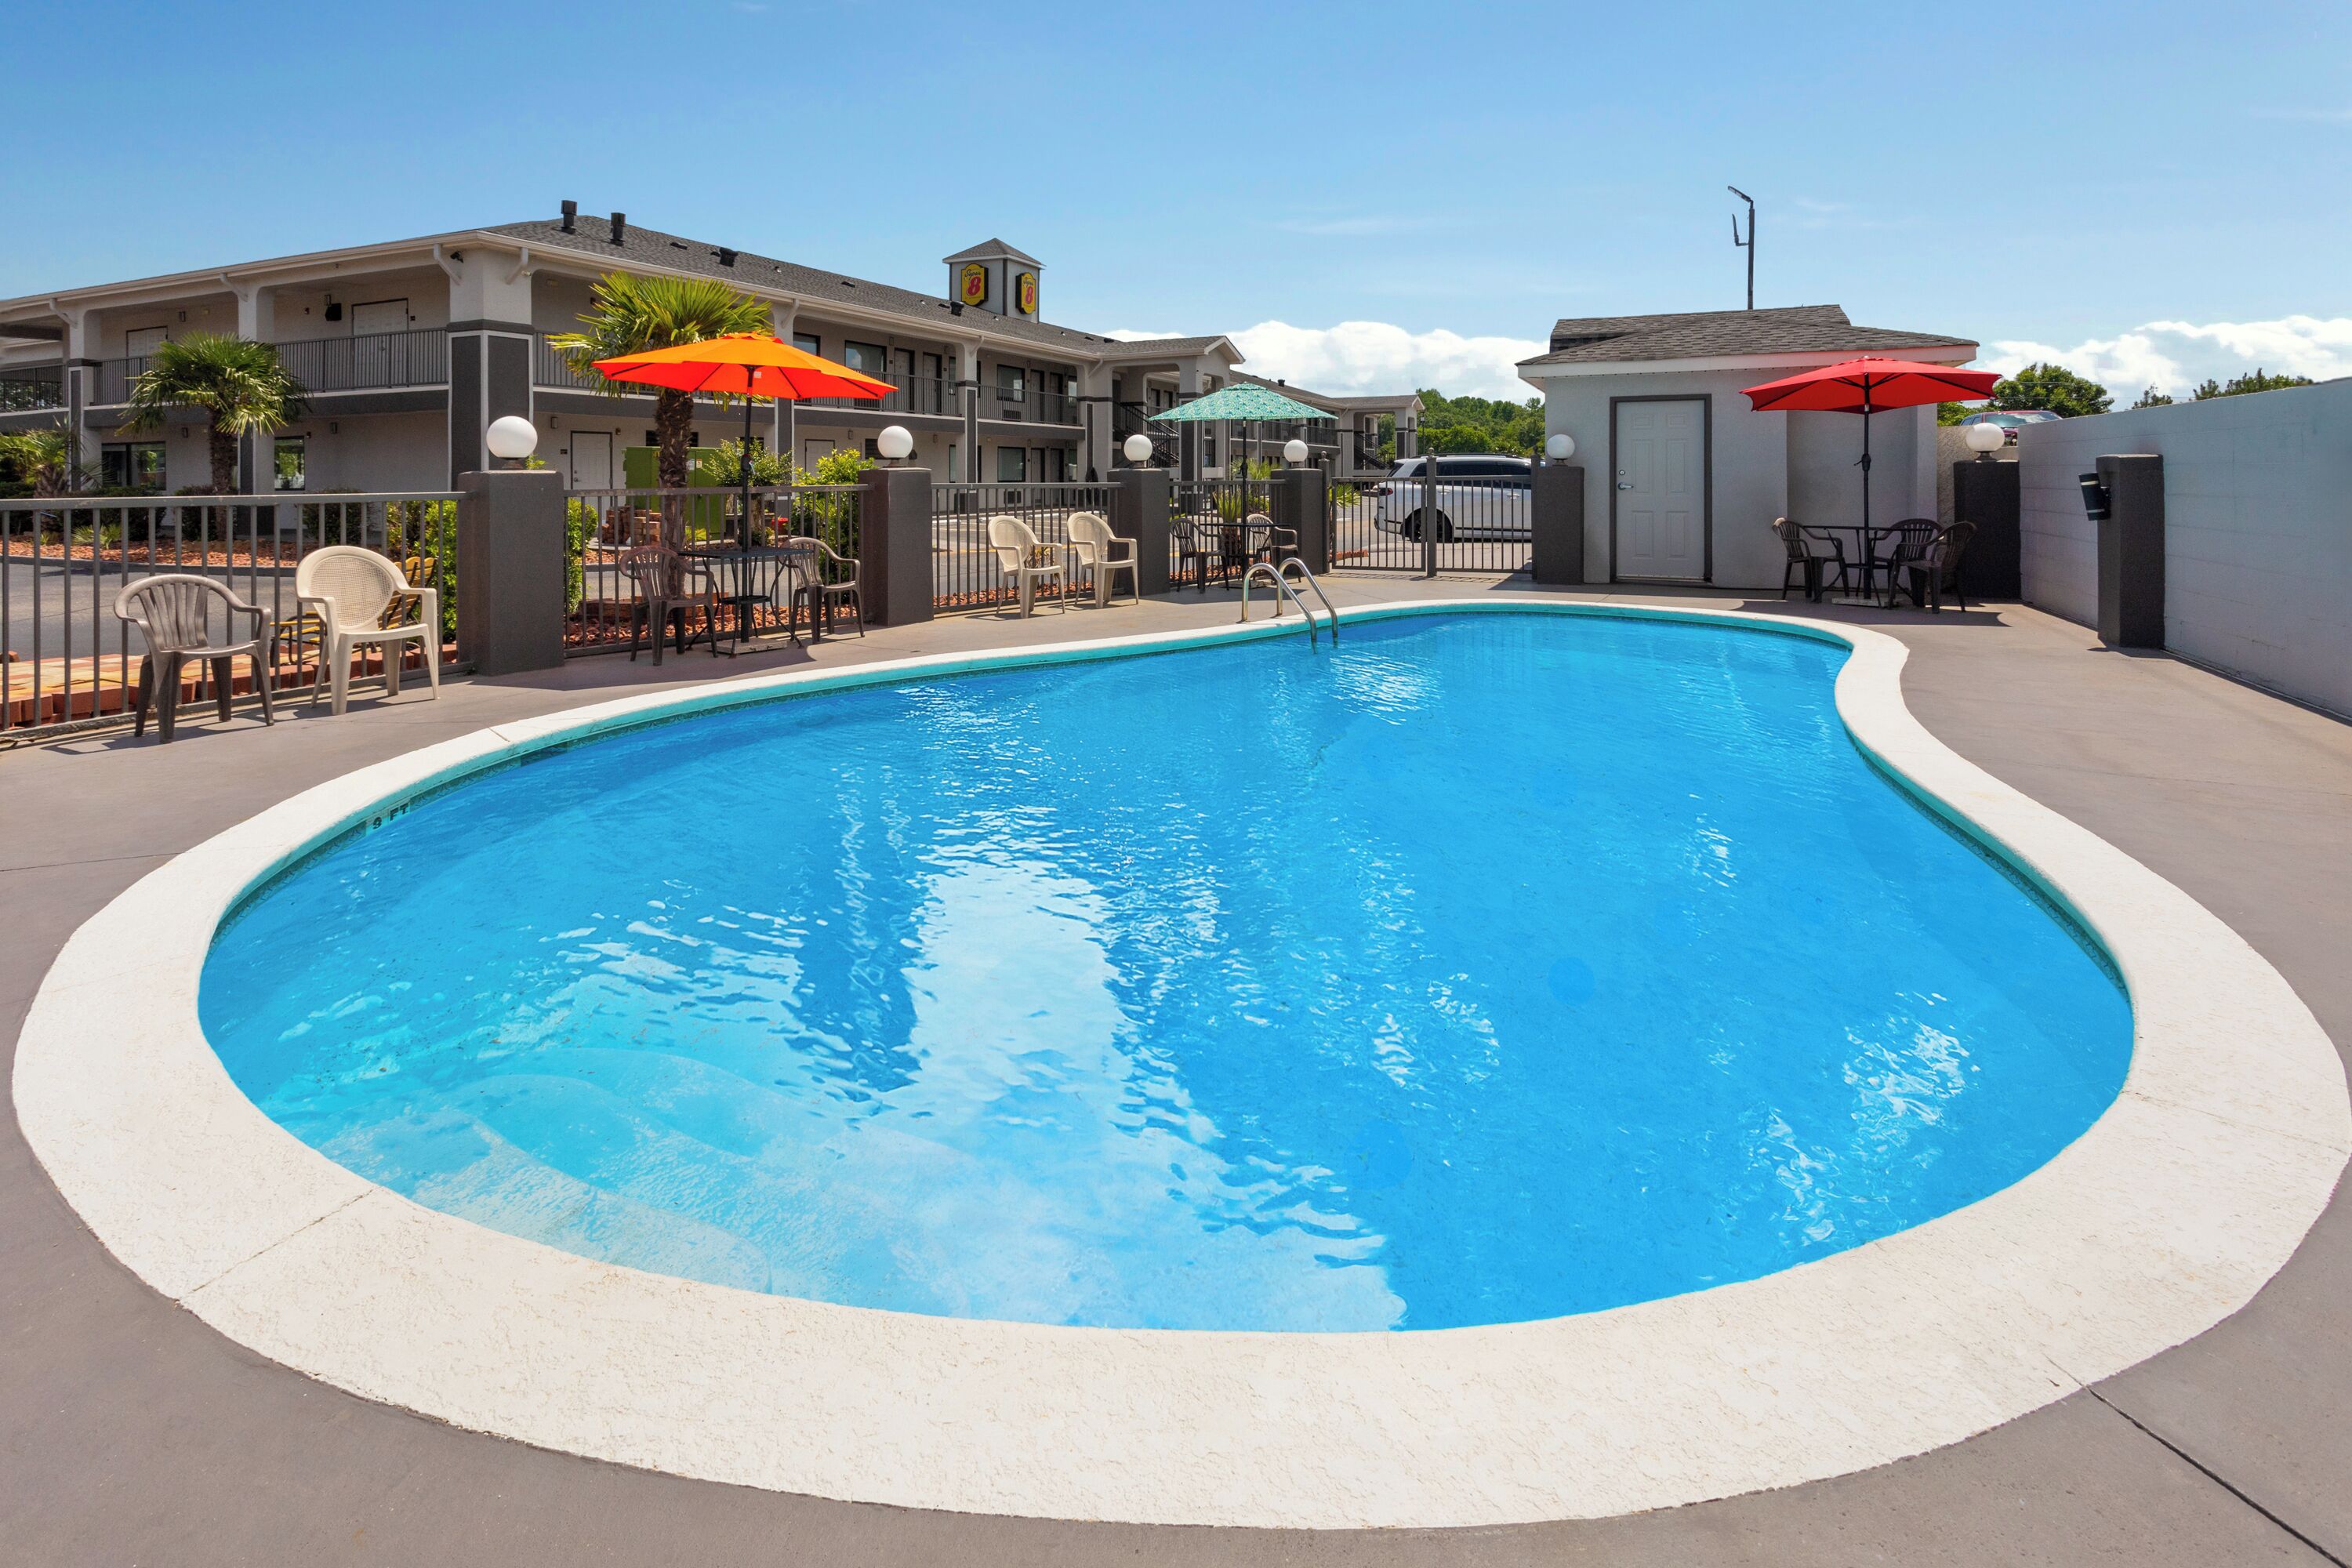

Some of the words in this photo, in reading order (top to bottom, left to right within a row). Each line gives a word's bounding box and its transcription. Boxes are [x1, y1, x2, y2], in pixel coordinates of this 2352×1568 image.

[965, 269, 981, 281] Super
[966, 276, 981, 296] 8
[1025, 286, 1033, 304] 8
